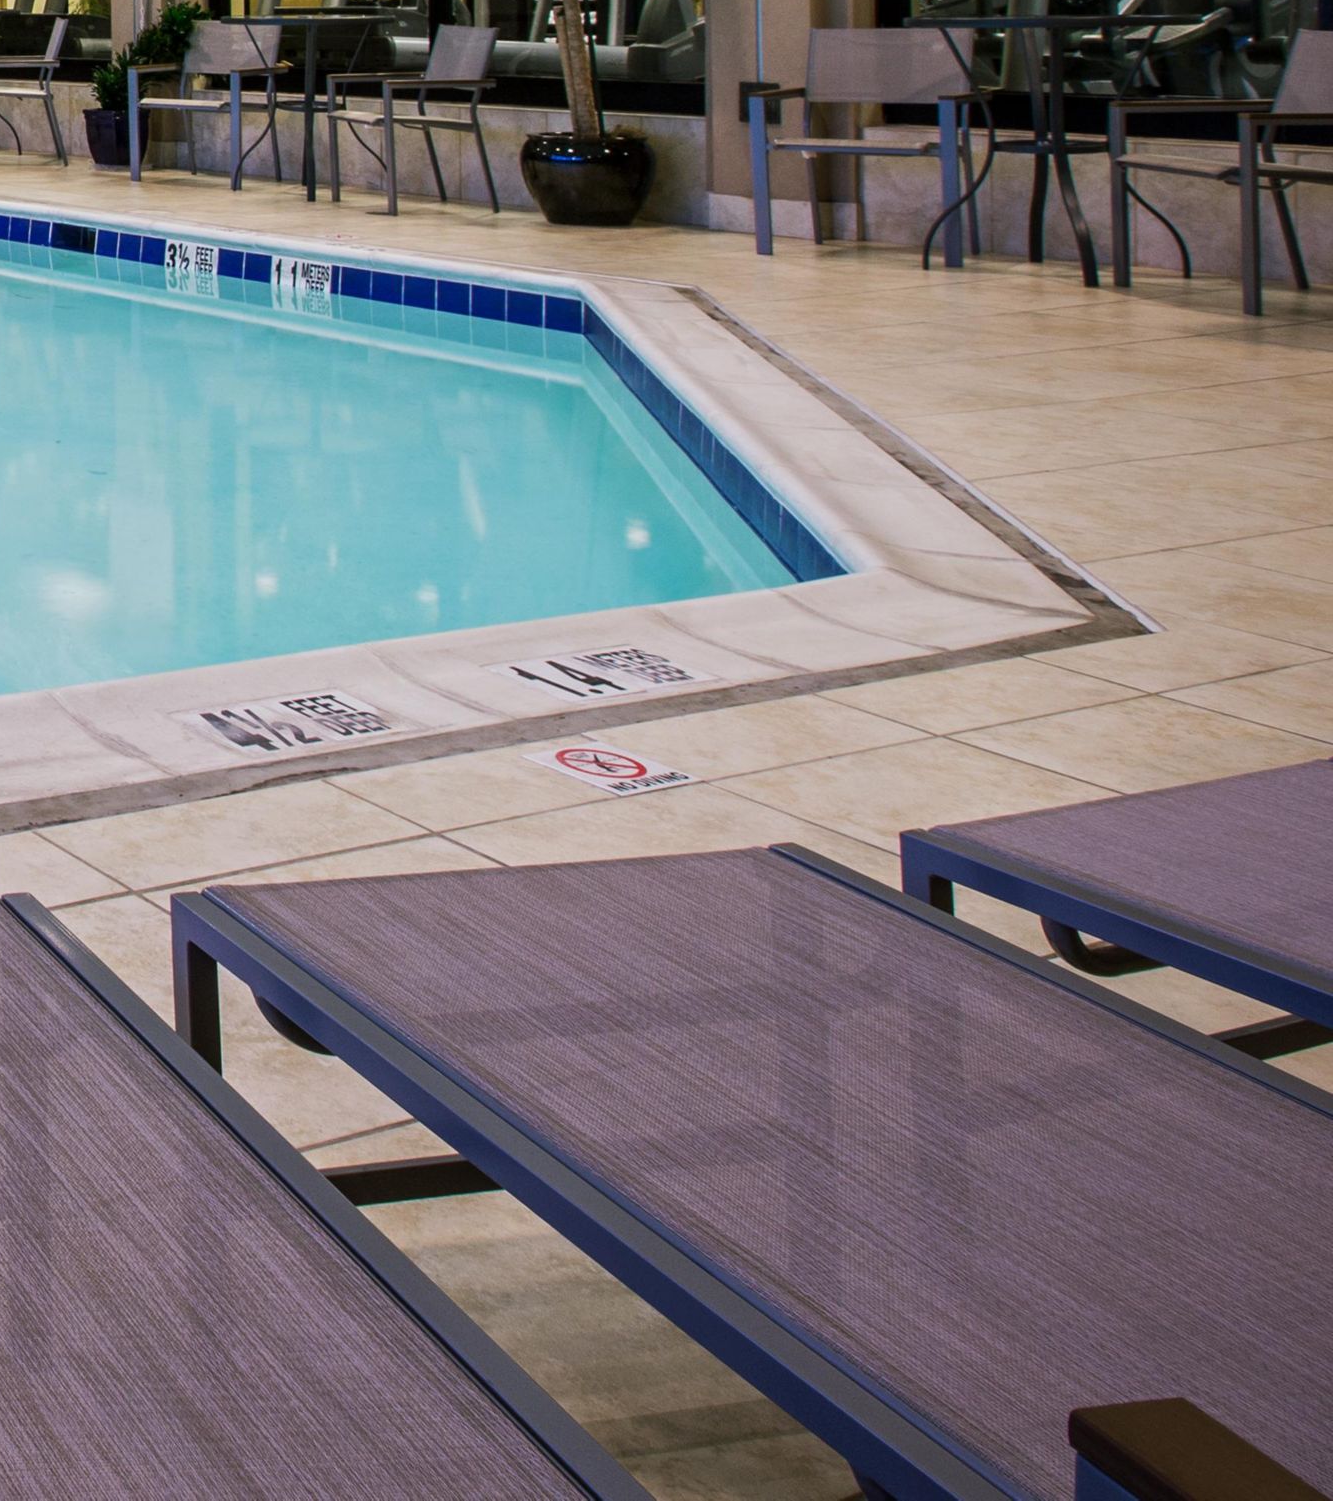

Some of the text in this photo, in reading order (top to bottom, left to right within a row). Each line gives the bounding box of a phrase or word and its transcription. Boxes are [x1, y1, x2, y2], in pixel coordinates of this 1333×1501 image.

[195, 246, 214, 263] FEET
[302, 263, 330, 282] METERS
[572, 648, 670, 671] METERS
[509, 660, 628, 697] 1.4
[622, 664, 694, 683] DEEP
[279, 694, 358, 718] FEET
[312, 711, 392, 736] DEEP
[607, 771, 690, 792] NO DIVING
